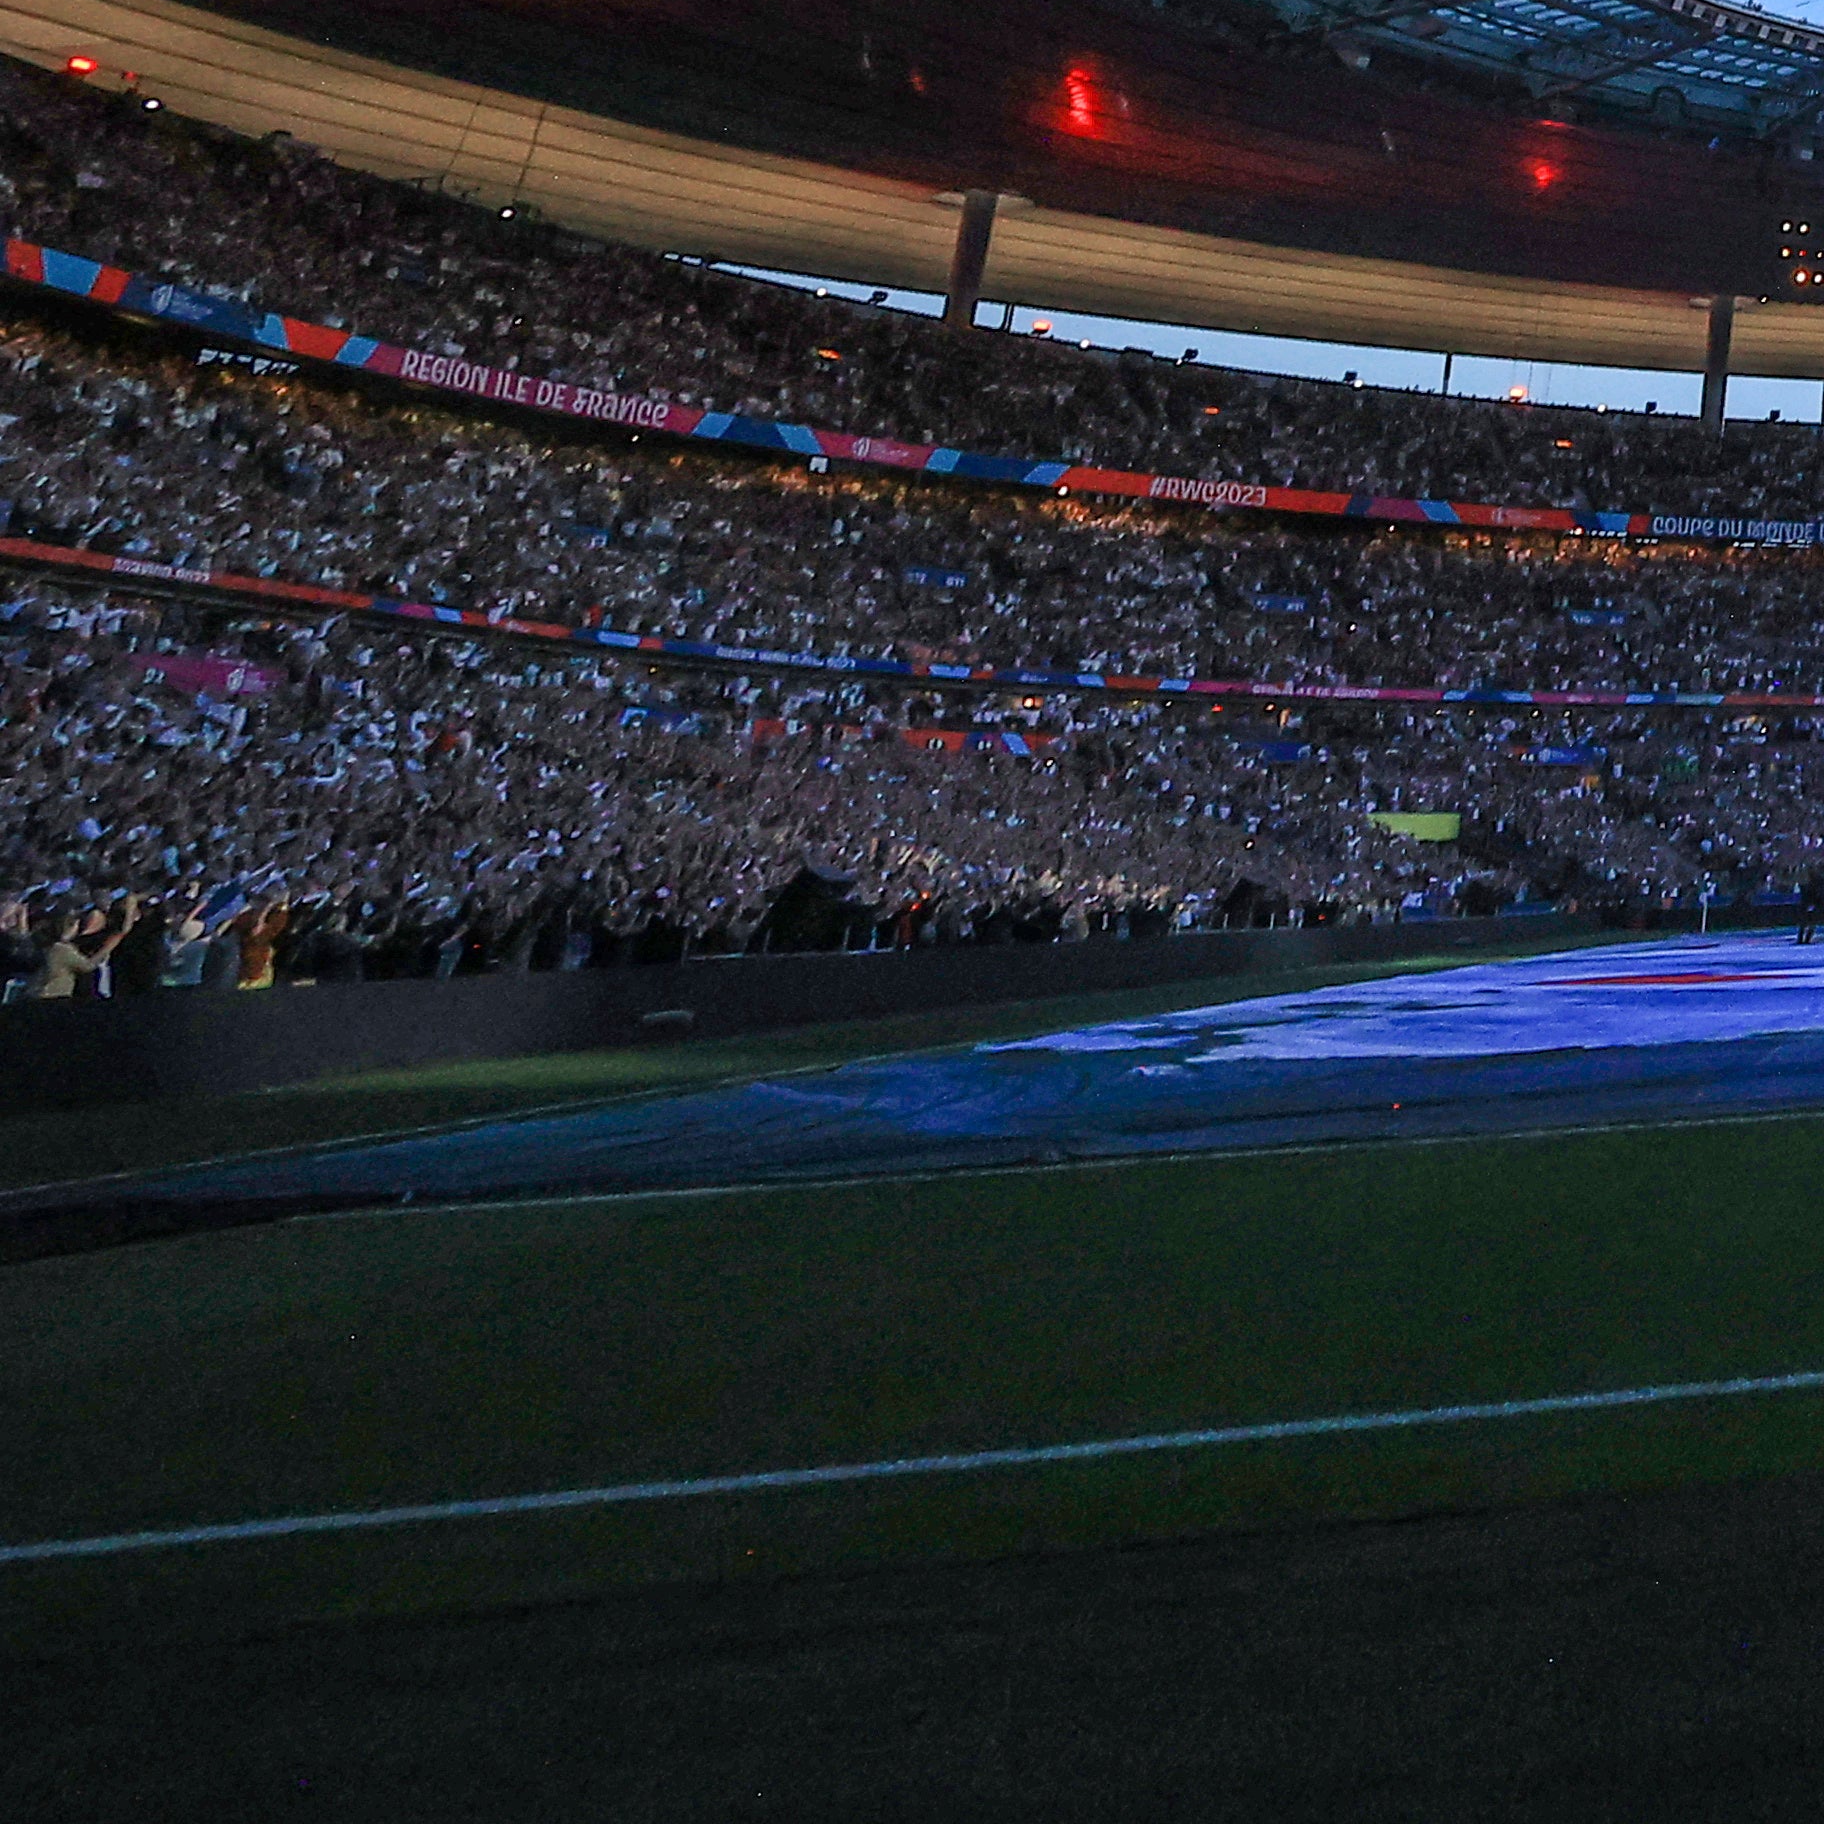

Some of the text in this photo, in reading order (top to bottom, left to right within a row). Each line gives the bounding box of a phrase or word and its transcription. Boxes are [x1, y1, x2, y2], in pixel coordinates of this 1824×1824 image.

[534, 379, 568, 409] DE
[1150, 475, 1267, 507] #RWC2023
[1717, 518, 1744, 537] DU
